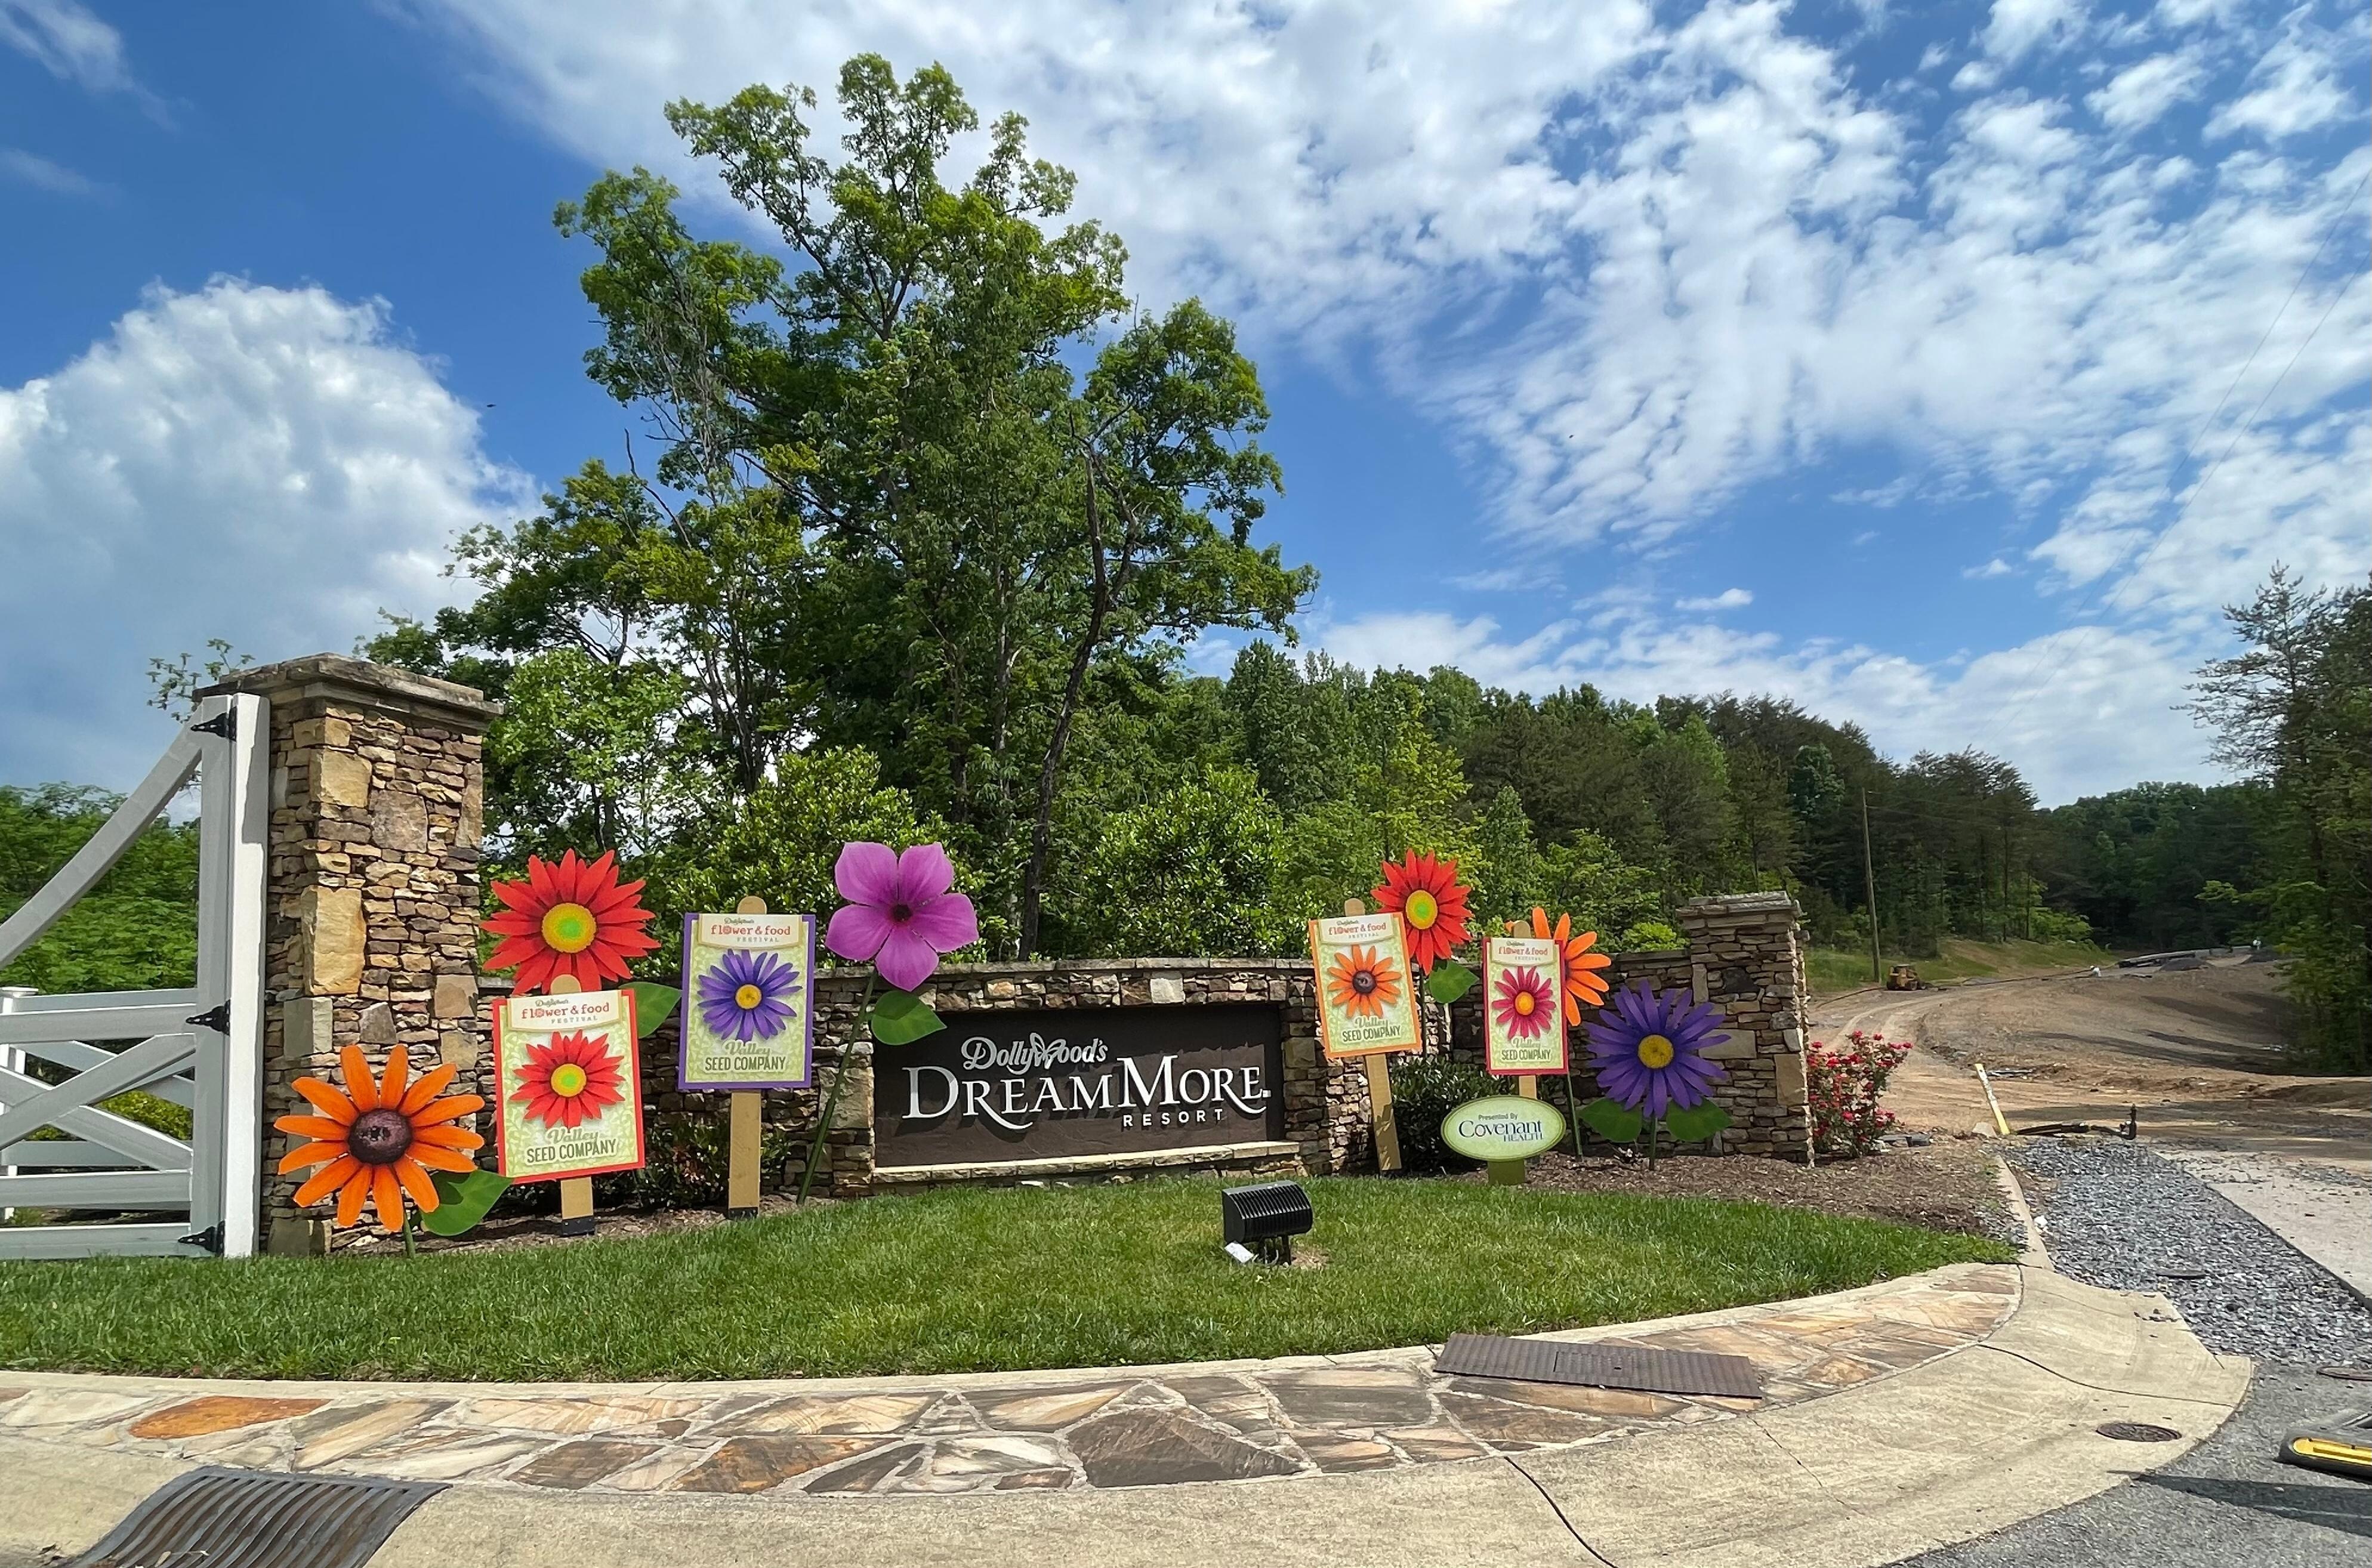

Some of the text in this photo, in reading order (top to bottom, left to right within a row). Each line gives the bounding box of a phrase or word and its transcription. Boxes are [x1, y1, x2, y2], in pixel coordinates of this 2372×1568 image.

[711, 925, 791, 935] flower & food
[1368, 922, 1386, 931] food
[522, 1008, 568, 1019] flower
[570, 1005, 578, 1014] &
[581, 1002, 609, 1014] food
[551, 1016, 598, 1024] FESTIVAL
[1343, 1025, 1401, 1042] SEED COMPANY
[725, 1042, 770, 1055] Valley
[1501, 1050, 1551, 1060] SEED COMPANY
[705, 1056, 786, 1070] SEED COMPANY
[1123, 1109, 1224, 1127] RESORT
[547, 1128, 599, 1144] Valley
[1458, 1120, 1541, 1138] Covenant
[1503, 1132, 1543, 1142] HEALTH
[527, 1138, 616, 1163] SEED COMPANY
